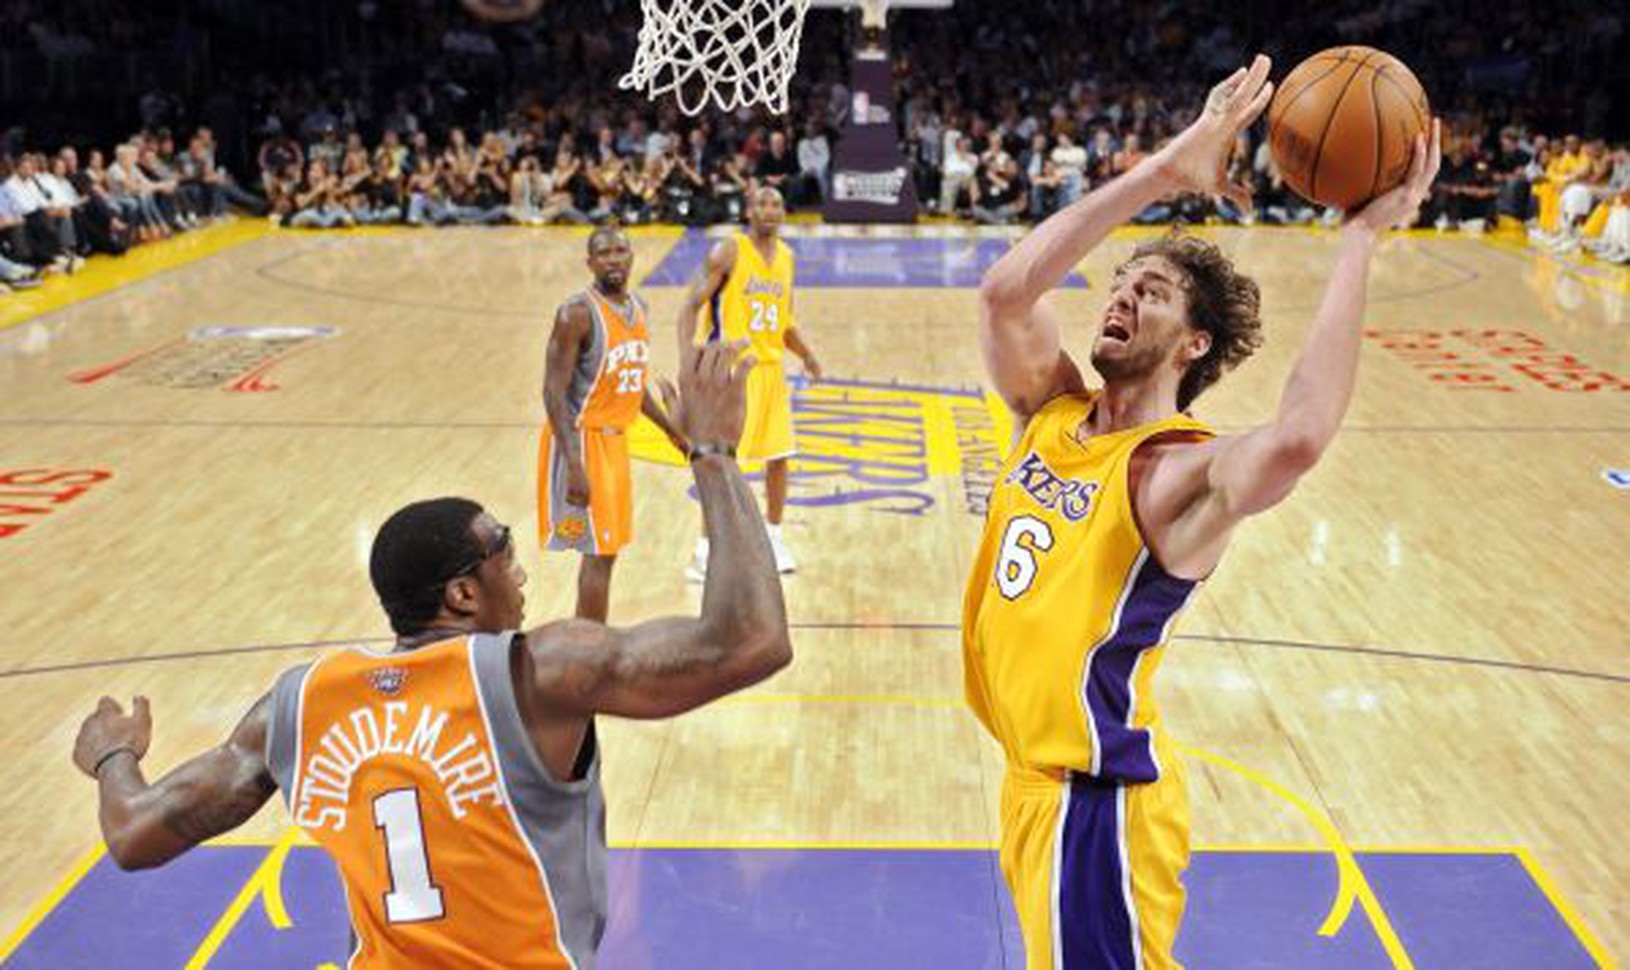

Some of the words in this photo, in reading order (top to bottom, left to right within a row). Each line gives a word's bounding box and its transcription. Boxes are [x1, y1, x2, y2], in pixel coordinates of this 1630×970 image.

[749, 300, 779, 331] 24
[619, 369, 642, 392] 23
[995, 514, 1055, 601] 6
[296, 701, 503, 832] STOUDEMIRE
[373, 786, 446, 924] 1
